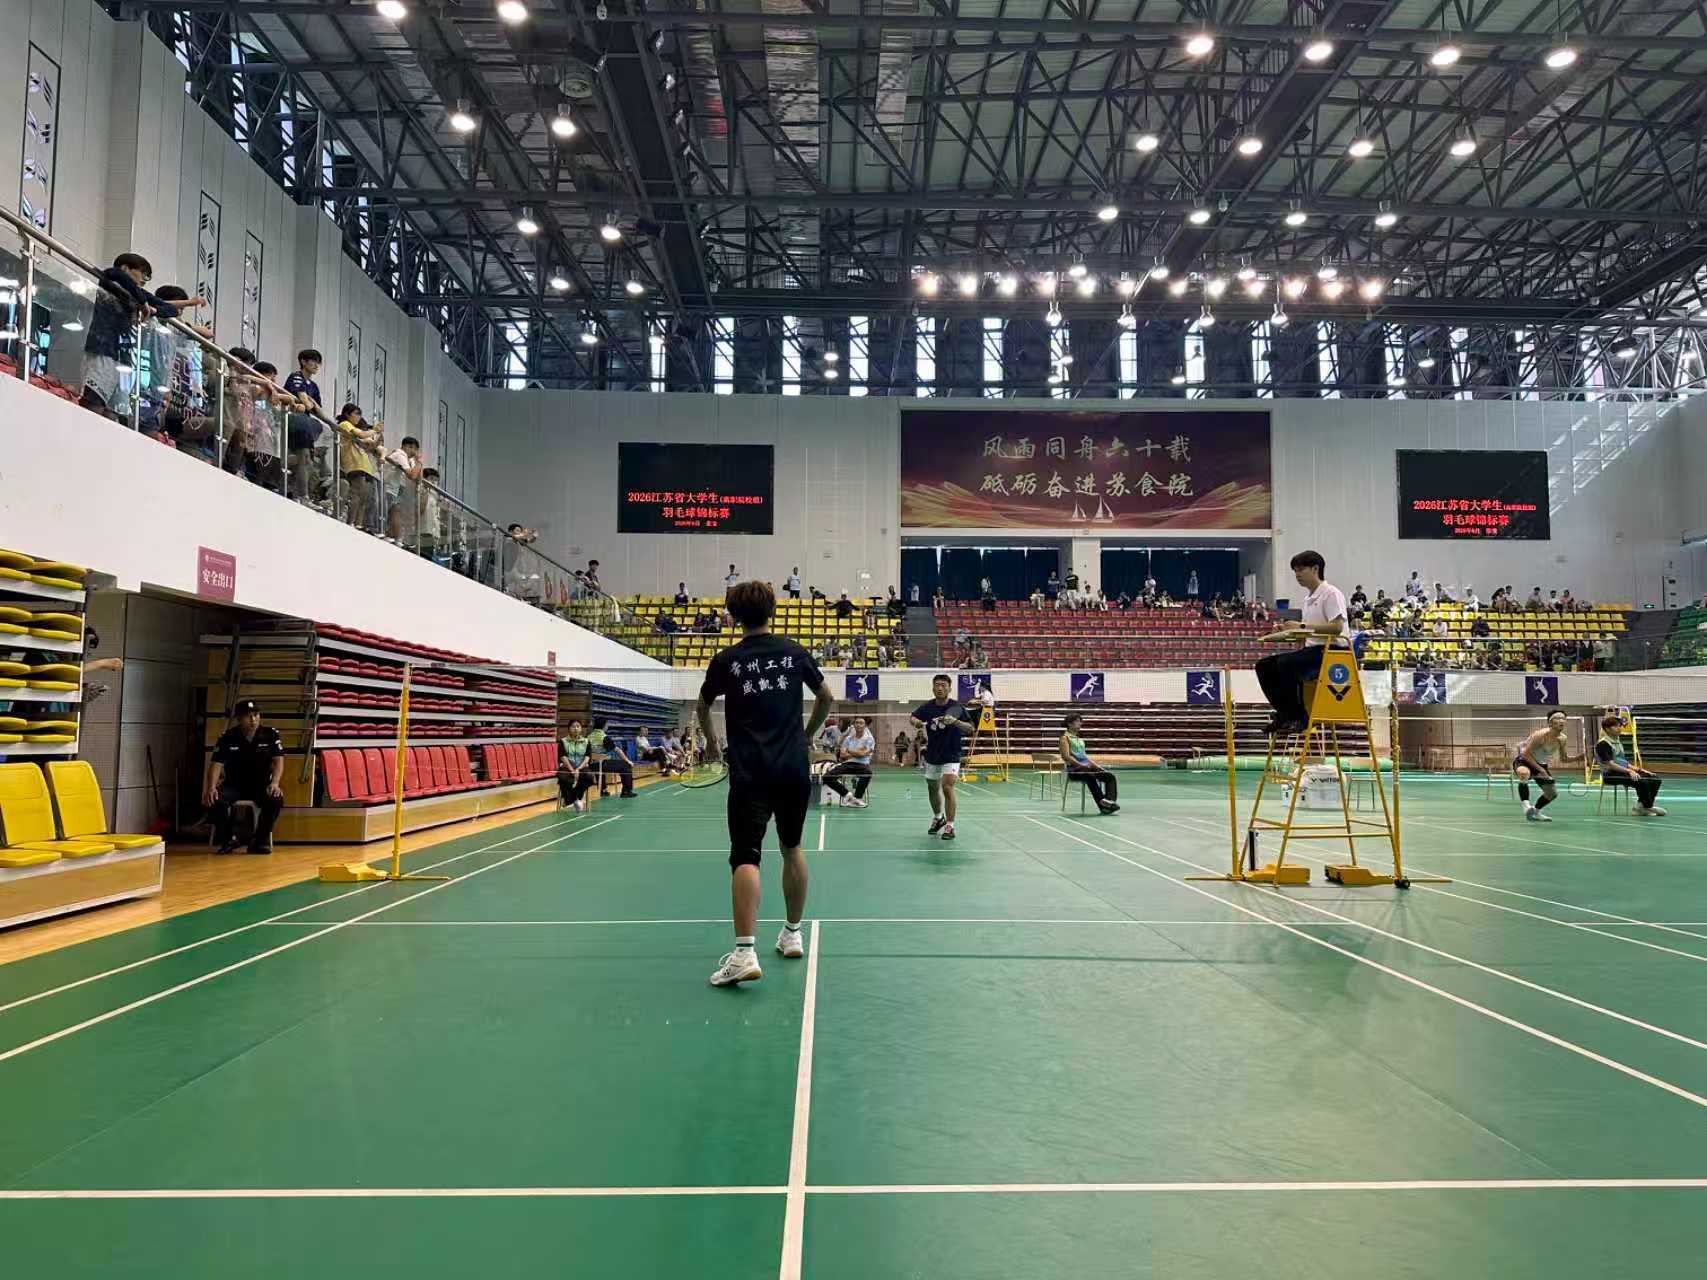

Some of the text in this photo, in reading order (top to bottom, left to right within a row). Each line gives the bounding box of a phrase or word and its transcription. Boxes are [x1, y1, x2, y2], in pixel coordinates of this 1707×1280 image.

[982, 435, 1192, 463] 风雨同舟六十载
[978, 470, 1193, 499] 砥砺奋进苏食院
[662, 507, 730, 518] 羽毛球锦标赛
[1443, 514, 1509, 526] 羽毛球锦标赛
[202, 568, 233, 589] 安全出口
[1335, 668, 1343, 679] 5
